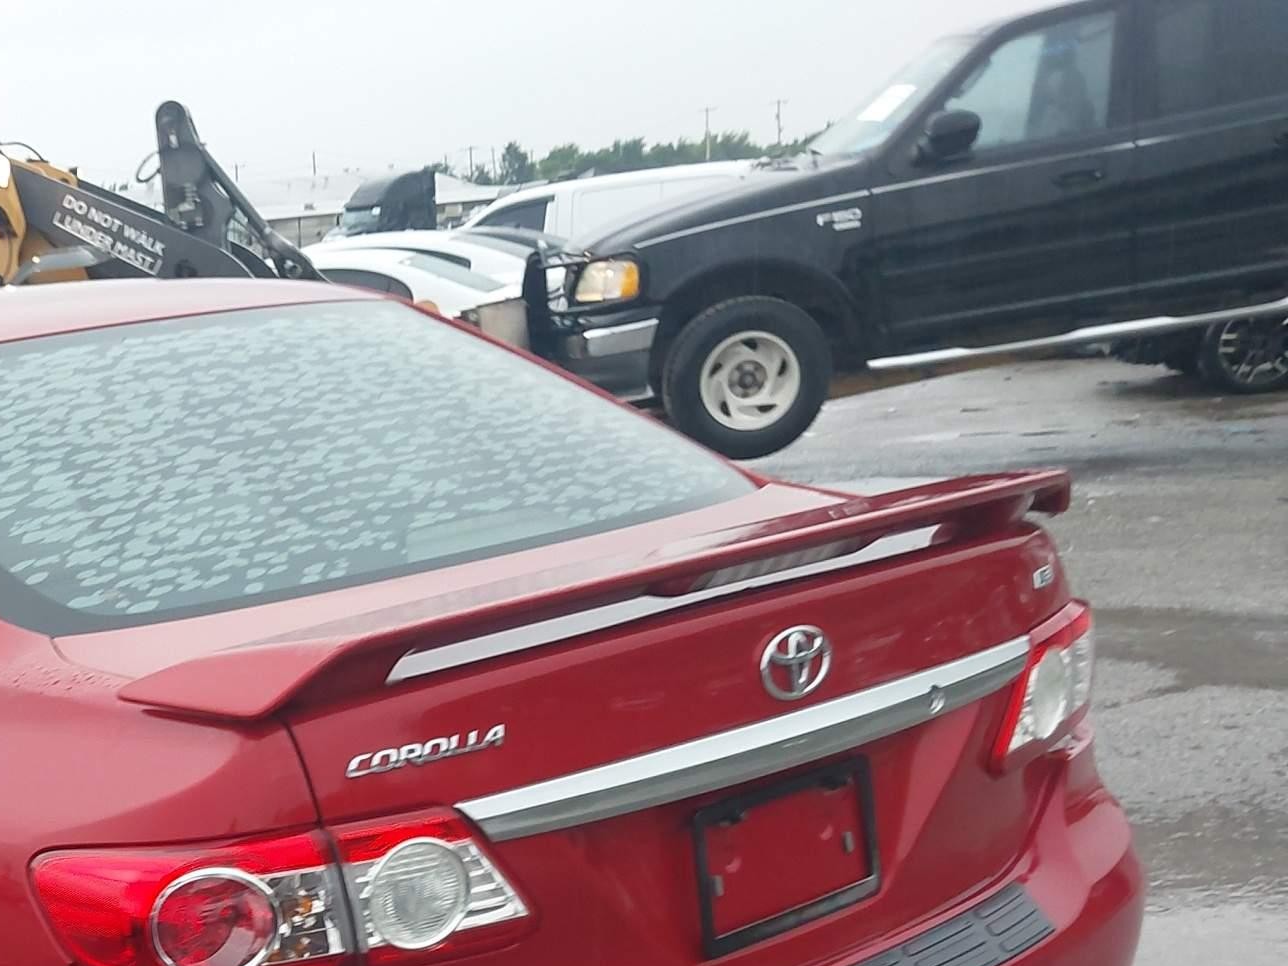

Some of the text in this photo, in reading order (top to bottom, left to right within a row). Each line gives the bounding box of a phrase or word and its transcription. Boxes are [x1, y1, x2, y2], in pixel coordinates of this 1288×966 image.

[62, 194, 166, 257] DO NOT WALK
[113, 241, 155, 270] MAST
[345, 723, 506, 778] COROLLA
